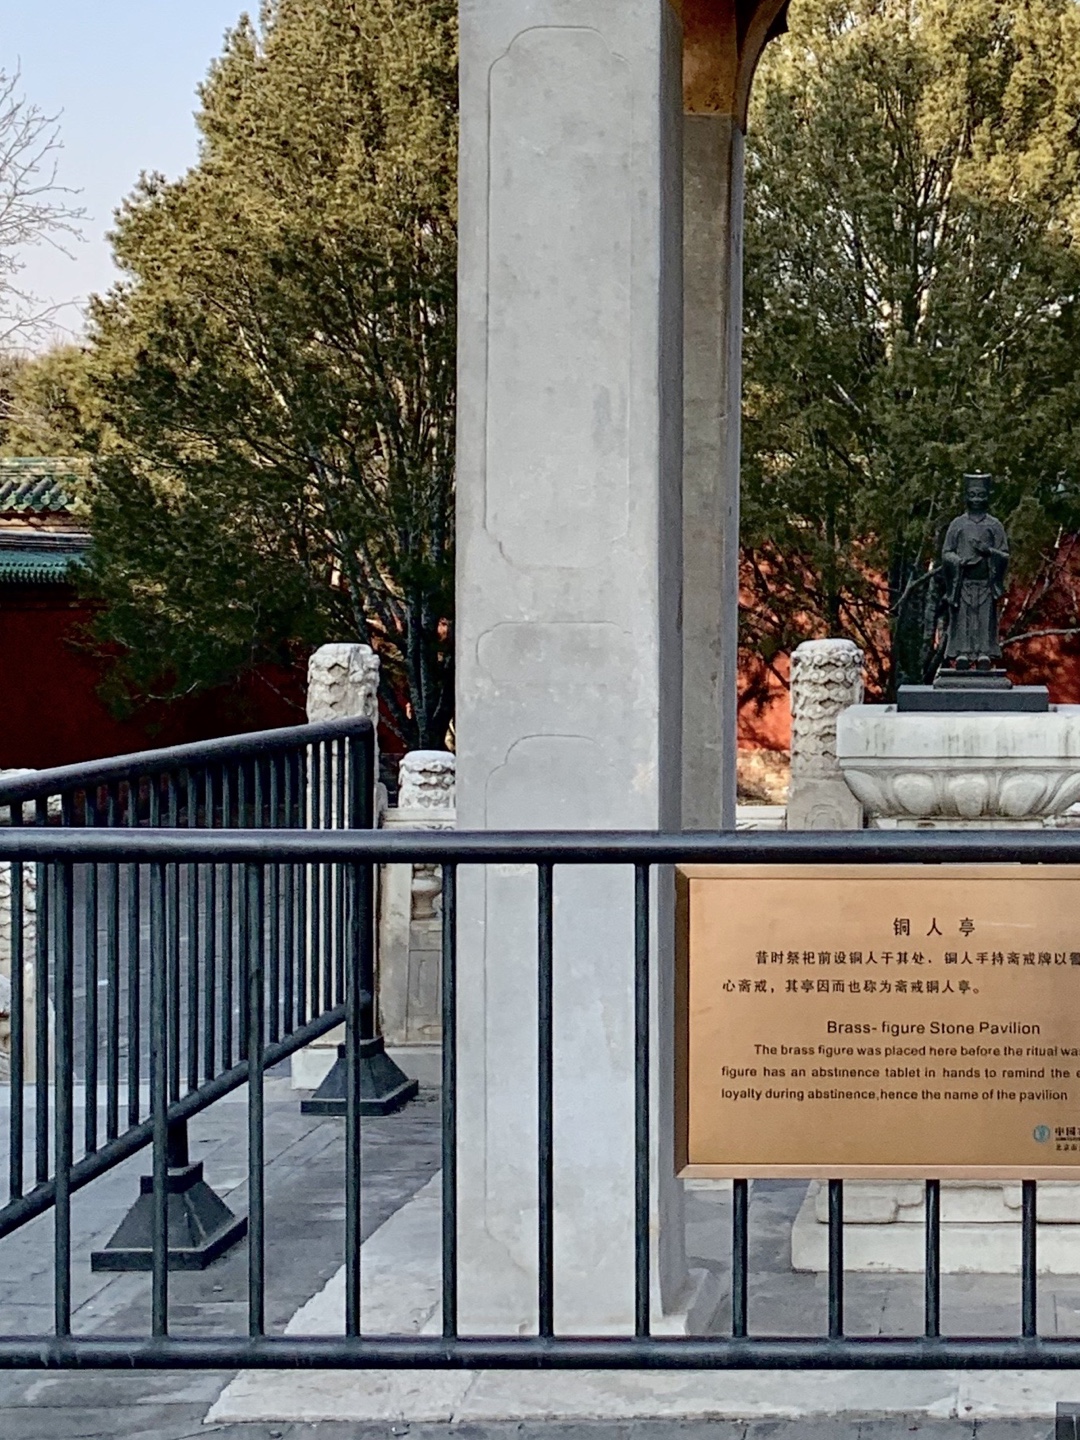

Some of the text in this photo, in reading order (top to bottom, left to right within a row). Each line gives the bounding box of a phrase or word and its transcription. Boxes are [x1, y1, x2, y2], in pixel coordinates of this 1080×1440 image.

[892, 916, 976, 938] 铜人亭
[881, 1021, 926, 1037] figure
[930, 1021, 975, 1035] Stone
[979, 1022, 1041, 1035] Pavilion
[754, 1044, 778, 1055] The
[781, 1044, 815, 1056] brass
[818, 1045, 853, 1058] figure
[857, 1047, 882, 1056] was
[885, 1045, 926, 1058] placed
[929, 1046, 958, 1057] here
[961, 1046, 1001, 1057] before
[1003, 1046, 1023, 1057] the
[1026, 1046, 1058, 1057] ritual
[722, 1066, 757, 1079] figure
[763, 1067, 786, 1078] has
[791, 1068, 806, 1078] an
[811, 1067, 880, 1078] abstinence
[885, 1067, 920, 1078] tablet
[925, 1067, 936, 1078] in
[943, 1067, 981, 1079] hands
[985, 1068, 997, 1079] to
[1002, 1067, 1045, 1079] remind
[1051, 1068, 1071, 1079] the
[721, 1088, 762, 1101] loyalty
[765, 1088, 804, 1102] during
[922, 1089, 941, 1100] the
[944, 1091, 979, 1101] name
[982, 1089, 994, 1100] of
[997, 1089, 1016, 1101] the
[1019, 1089, 1068, 1103] pavilion
